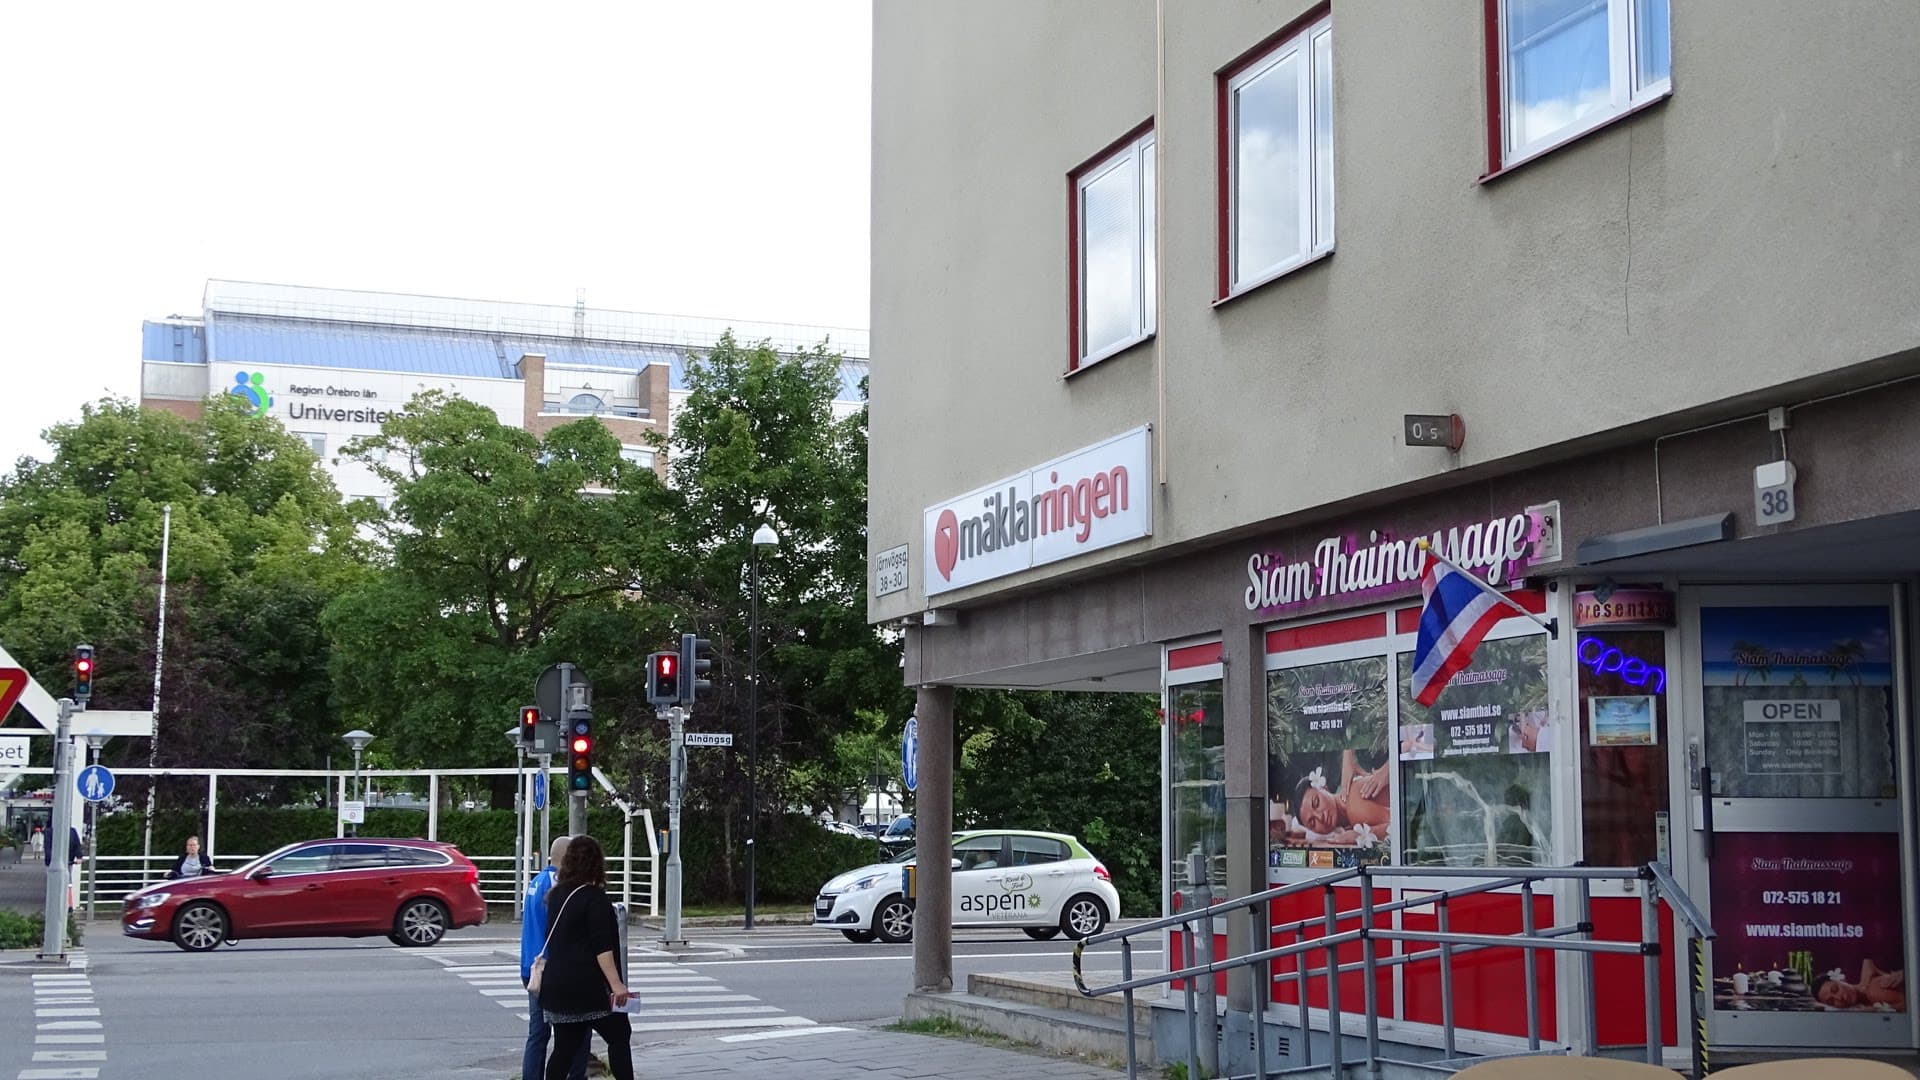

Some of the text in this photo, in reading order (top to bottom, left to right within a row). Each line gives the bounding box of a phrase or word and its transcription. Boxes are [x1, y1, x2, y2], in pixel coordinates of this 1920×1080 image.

[290, 384, 378, 398] Region Örebro län
[1762, 489, 1789, 516] 38
[960, 465, 1128, 560] mäklarringen
[1245, 513, 1527, 611] Siam Thaimassage
[1440, 704, 1502, 721] www.siamthai.se
[1762, 703, 1822, 719] OPEN
[687, 734, 731, 744] Alnängsg
[960, 893, 1025, 916] aspen
[1762, 890, 1841, 905] 072-575 18 21
[1746, 922, 1864, 938] www.siamthai.se
